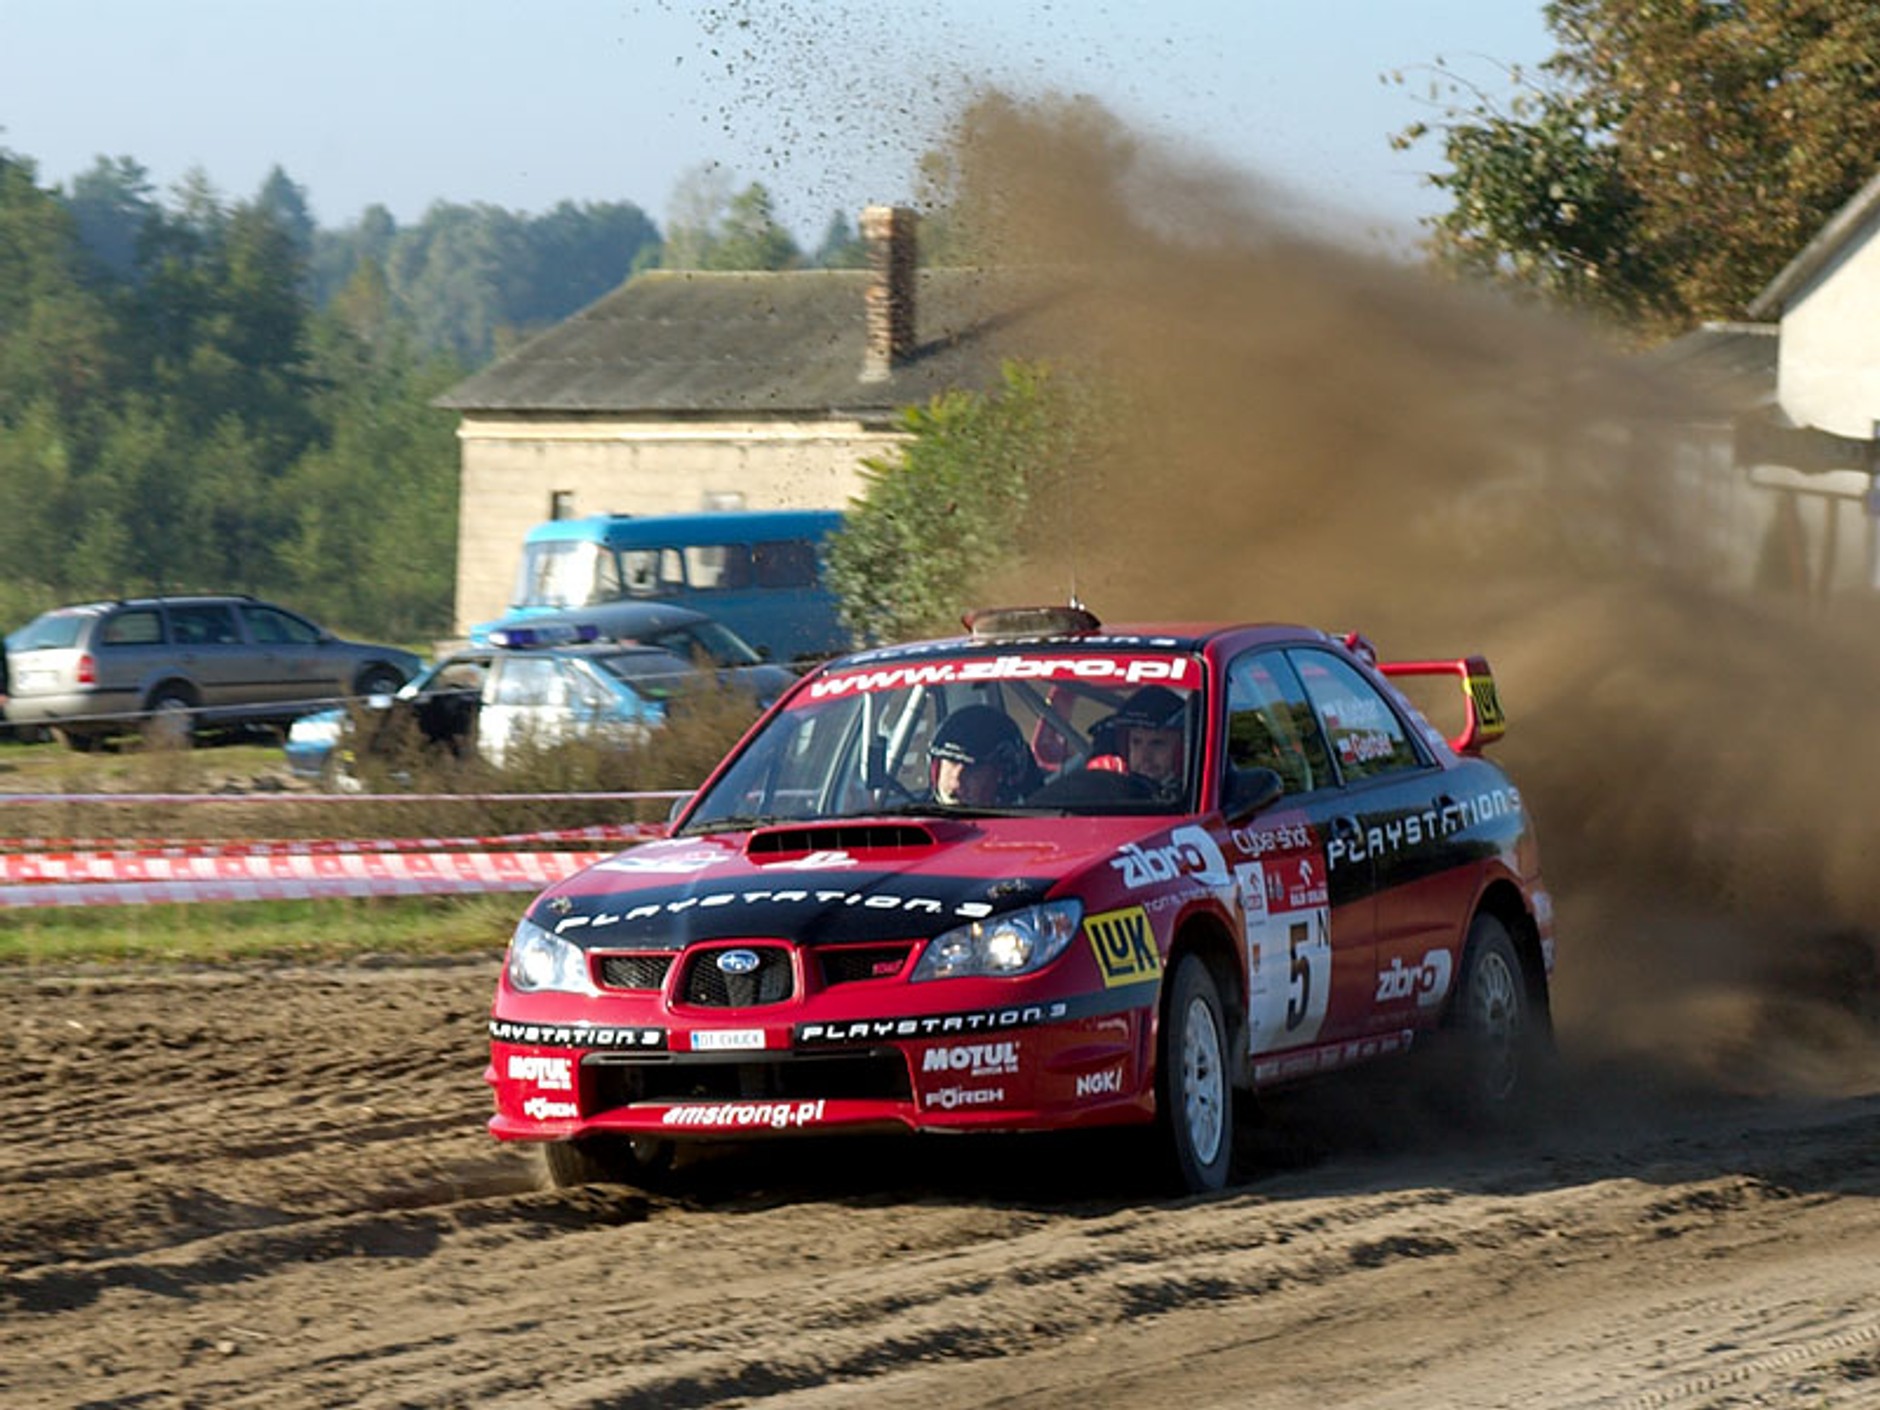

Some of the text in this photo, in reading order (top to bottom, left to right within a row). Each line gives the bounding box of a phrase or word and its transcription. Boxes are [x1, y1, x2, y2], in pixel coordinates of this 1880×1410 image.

[1111, 824, 1230, 890] zibro
[1091, 914, 1158, 977] LUK
[1287, 921, 1311, 1031] 5
[1375, 949, 1453, 1007] zibro
[801, 1007, 1041, 1041] PLAYSTATION
[922, 1041, 1018, 1073] MOTUL
[662, 1100, 825, 1128] amstrong.pl
